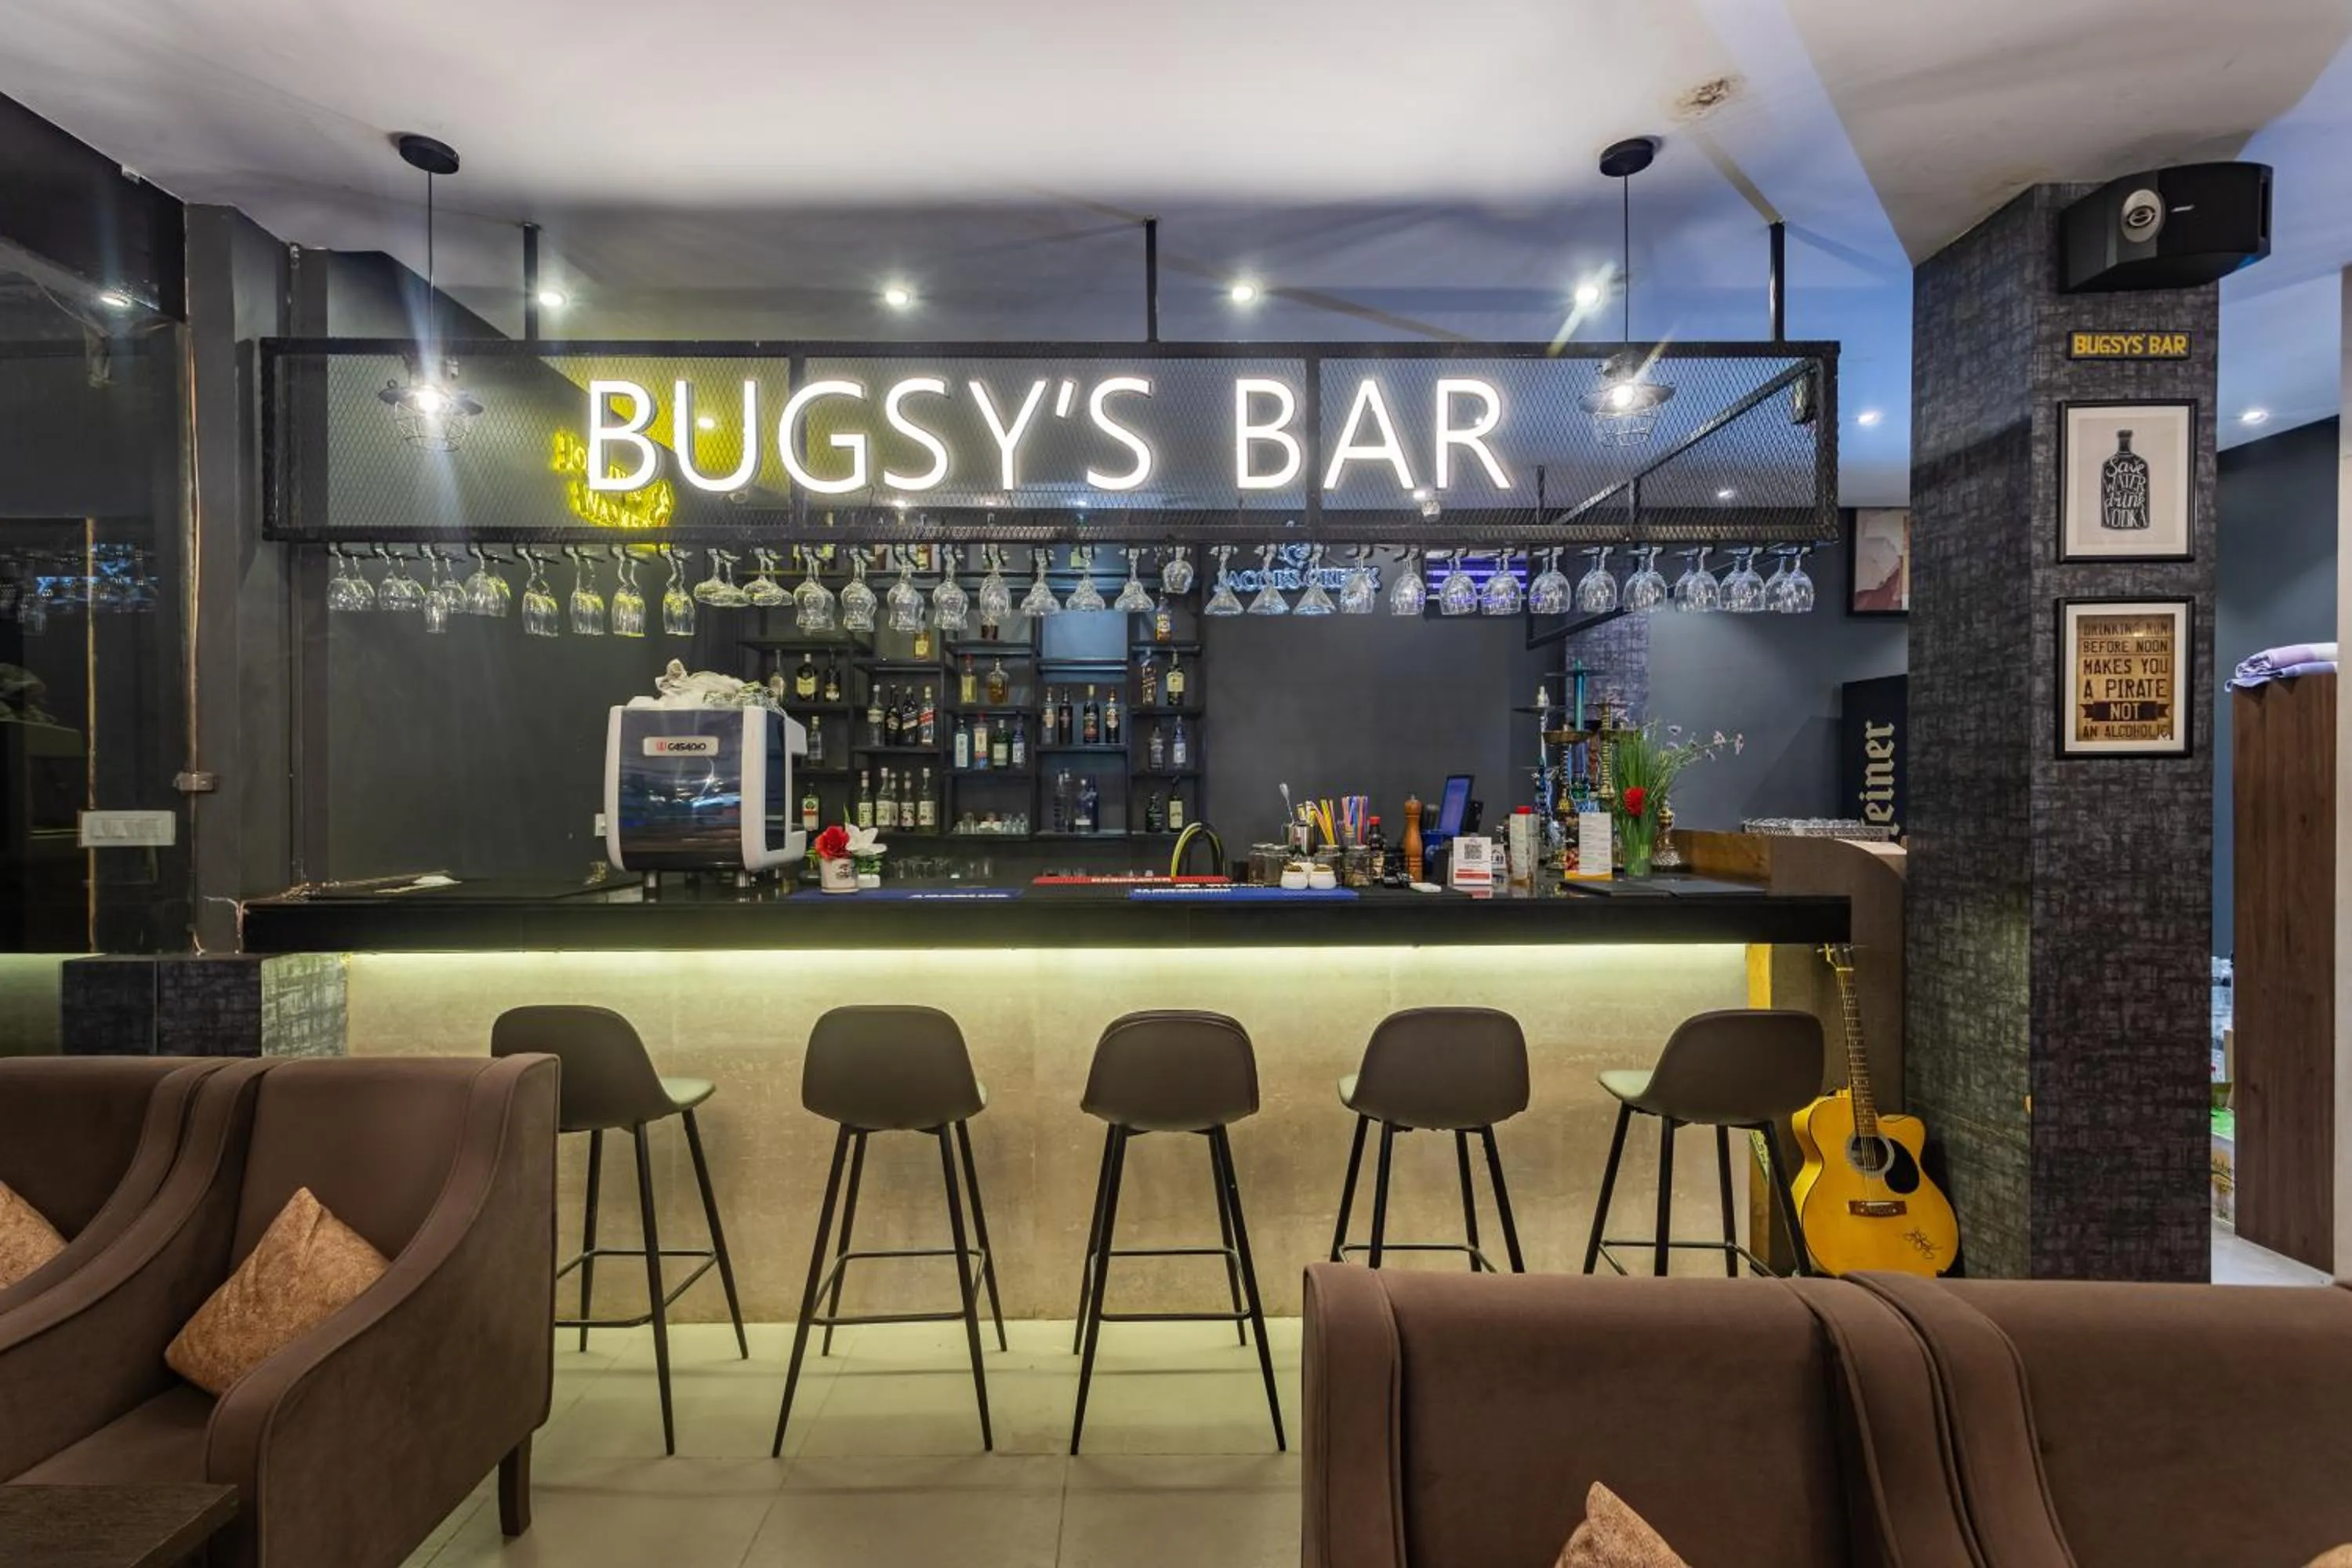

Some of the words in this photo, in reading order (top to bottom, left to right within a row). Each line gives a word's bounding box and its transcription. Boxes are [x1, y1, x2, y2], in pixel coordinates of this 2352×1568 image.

[2149, 335, 2187, 354] BAR
[588, 377, 1153, 493] BUGSY'S
[1235, 378, 1512, 490] BAR
[2104, 507, 2147, 528] VODKA
[2083, 641, 2130, 653] BEFORE
[2136, 639, 2168, 652] NOON
[2083, 659, 2132, 675] MAKES
[2141, 659, 2169, 675] YOU
[2084, 679, 2093, 698] A
[2105, 679, 2168, 698] PIRATE
[2110, 703, 2140, 720] NOT
[2083, 726, 2097, 737] AN
[1859, 719, 1900, 837] einer
